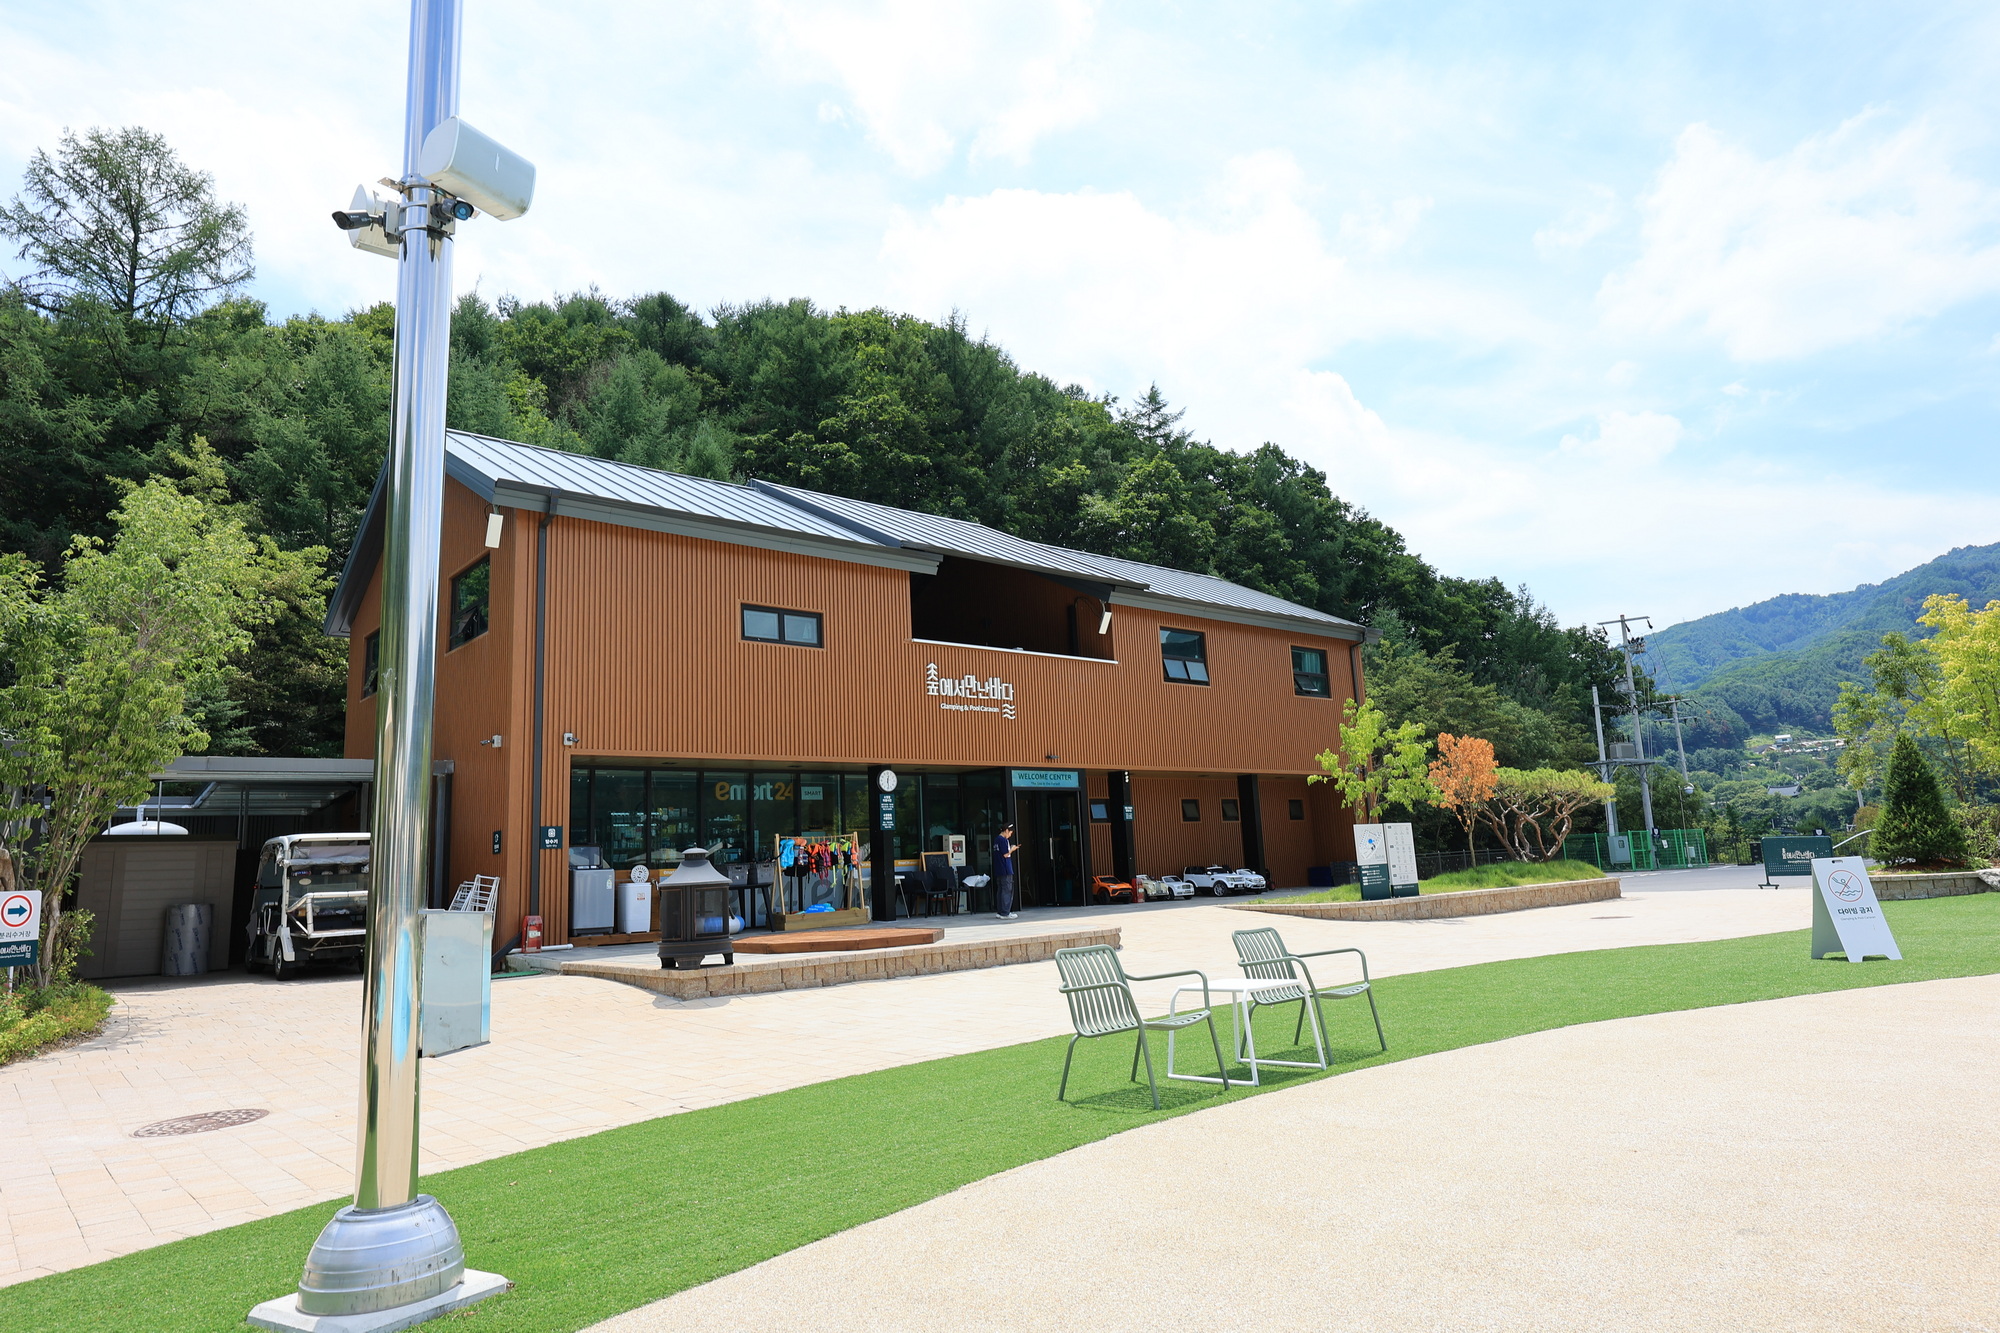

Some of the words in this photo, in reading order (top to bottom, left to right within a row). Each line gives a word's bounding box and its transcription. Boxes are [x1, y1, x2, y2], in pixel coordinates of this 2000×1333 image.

[940, 703, 963, 712] Glamping
[981, 705, 1000, 713] Caravan
[1837, 907, 1858, 915] 다이빙
[1859, 906, 1873, 914] 금지
